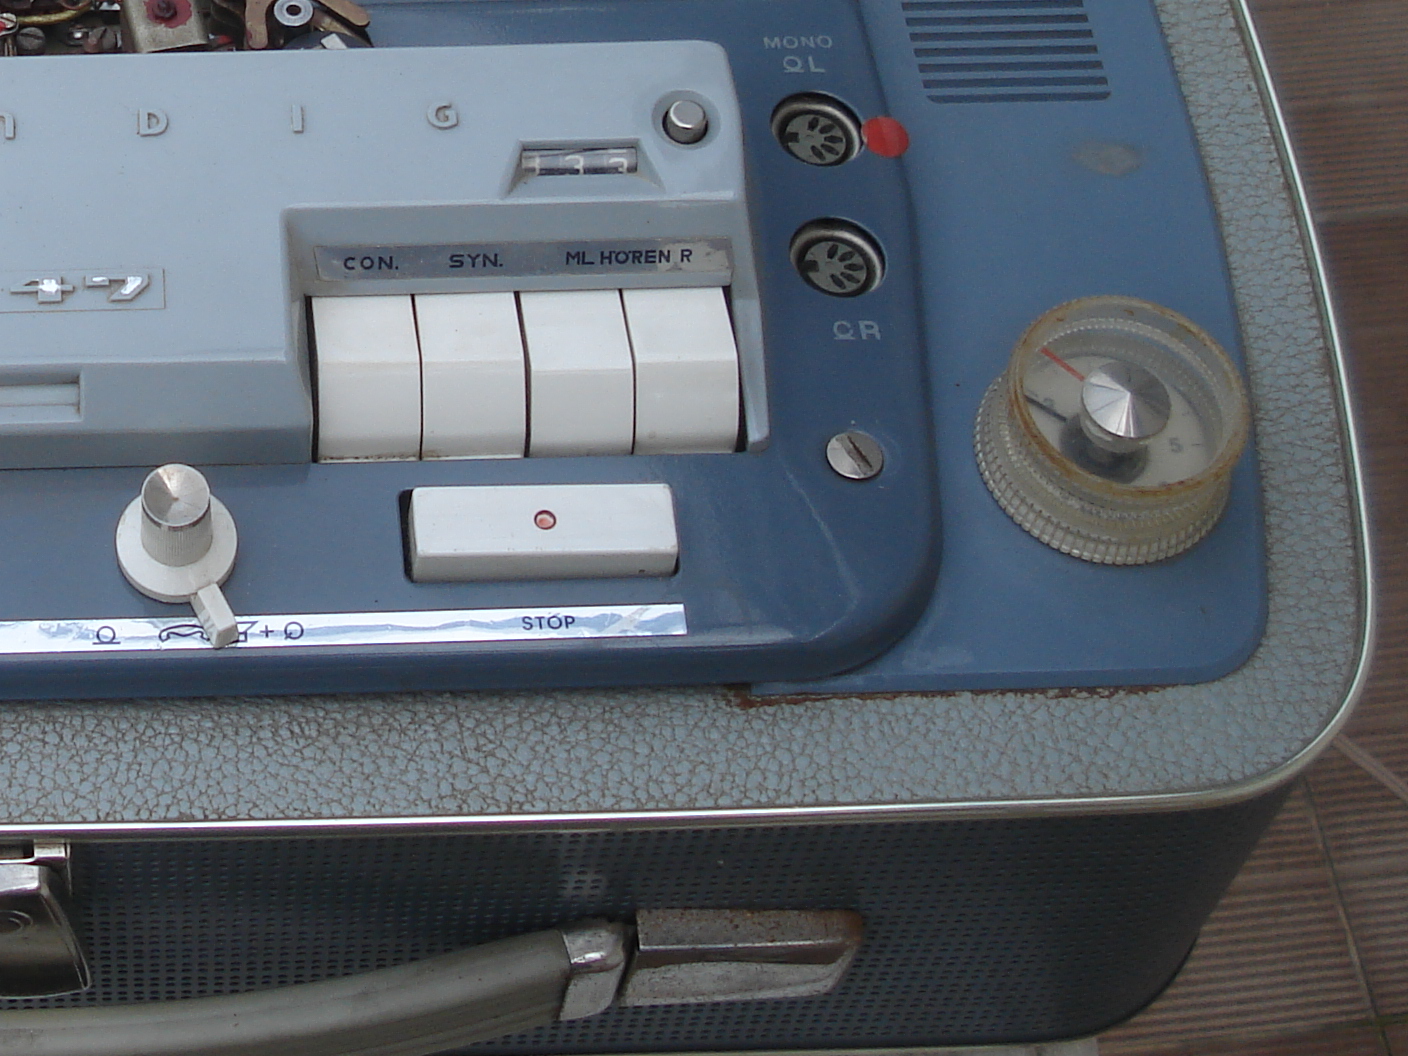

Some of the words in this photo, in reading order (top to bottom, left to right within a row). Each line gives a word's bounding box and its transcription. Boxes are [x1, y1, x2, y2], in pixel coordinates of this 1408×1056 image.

[763, 35, 833, 50] MONO
[343, 255, 399, 271] CON.
[448, 253, 504, 269] SYN.
[565, 250, 595, 265] ML
[680, 248, 693, 263] R
[9, 274, 151, 305] 47
[521, 615, 577, 631] STOP
